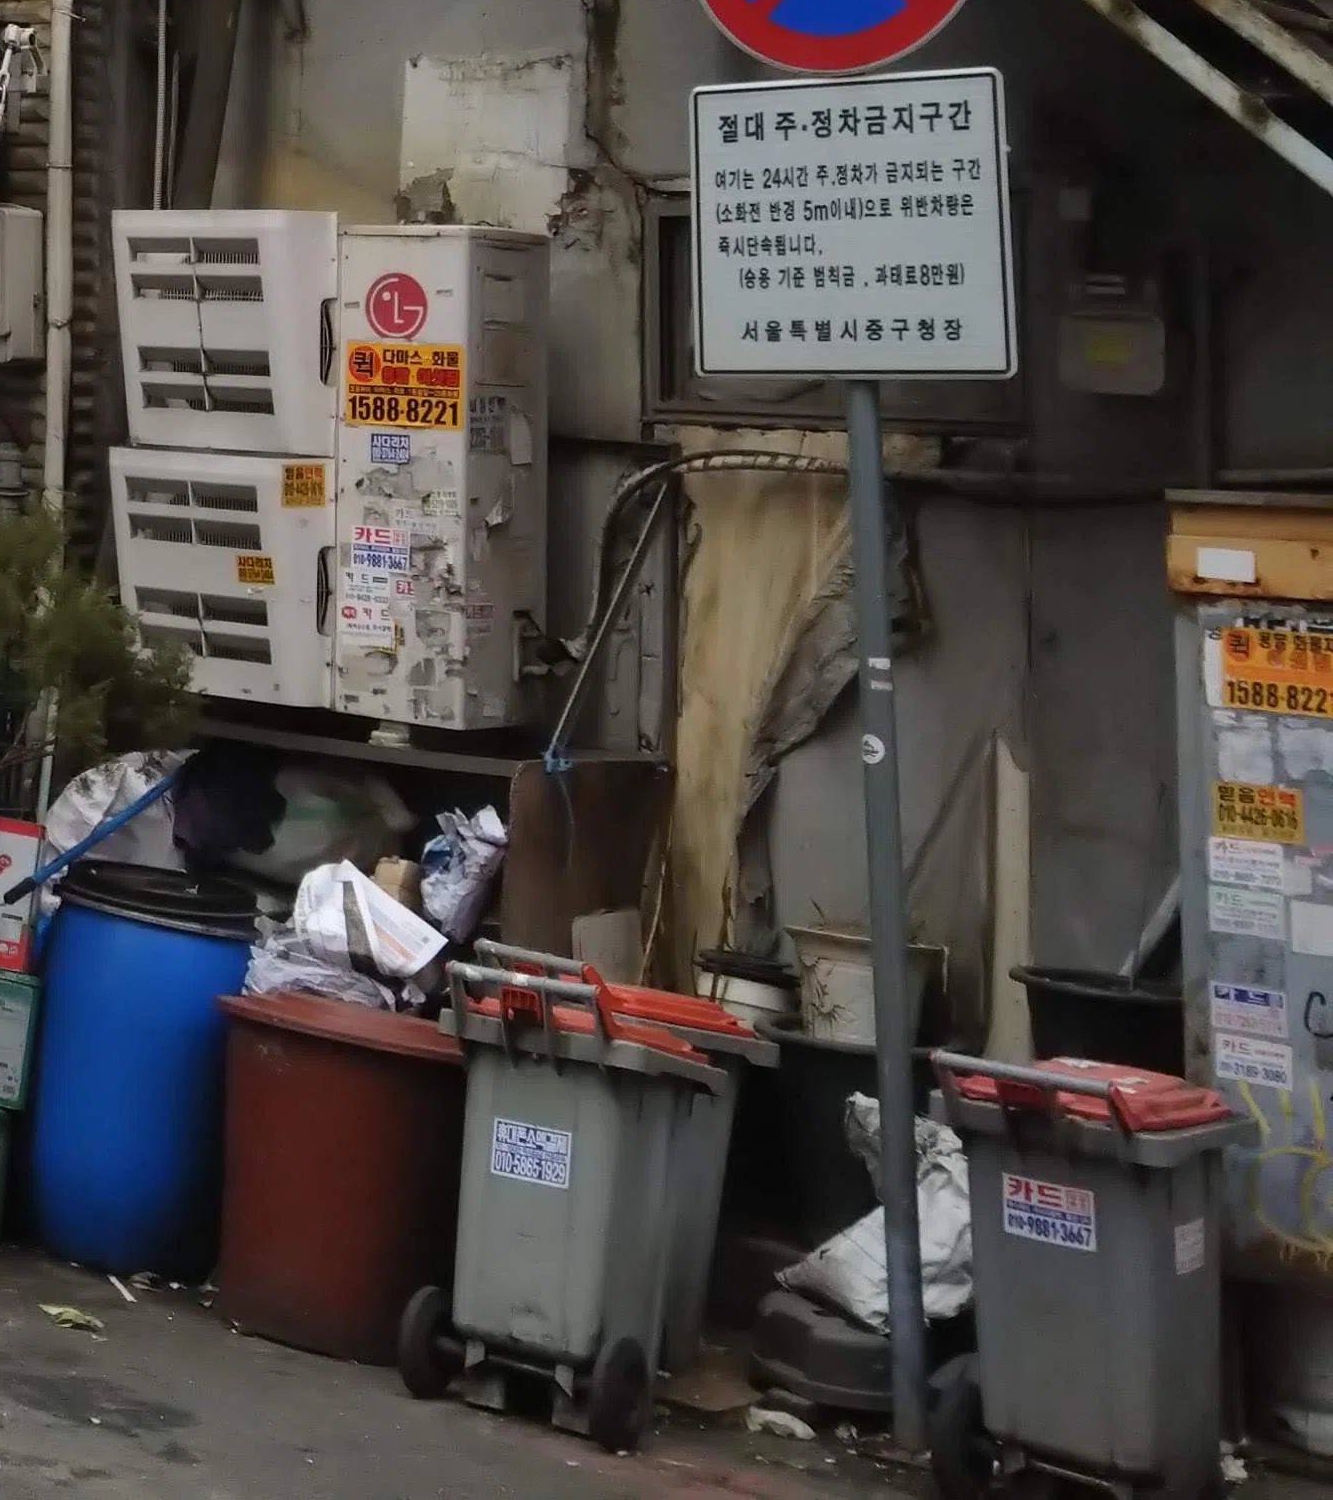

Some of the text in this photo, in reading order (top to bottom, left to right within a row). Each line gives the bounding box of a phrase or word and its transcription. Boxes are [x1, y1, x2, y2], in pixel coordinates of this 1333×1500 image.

[717, 109, 765, 145] 절대
[715, 169, 755, 190] 여기는
[763, 165, 809, 189] 24시간
[885, 160, 944, 184] 금지되는
[952, 157, 981, 181] 구간
[716, 202, 761, 224] (소화전
[769, 200, 795, 222] 반경
[901, 194, 974, 218] 위반차량은
[740, 267, 770, 290] (승용
[779, 266, 805, 289] 기준
[354, 350, 373, 378] 퀵
[354, 527, 391, 544] 카드
[1008, 1177, 1063, 1207] 카드
